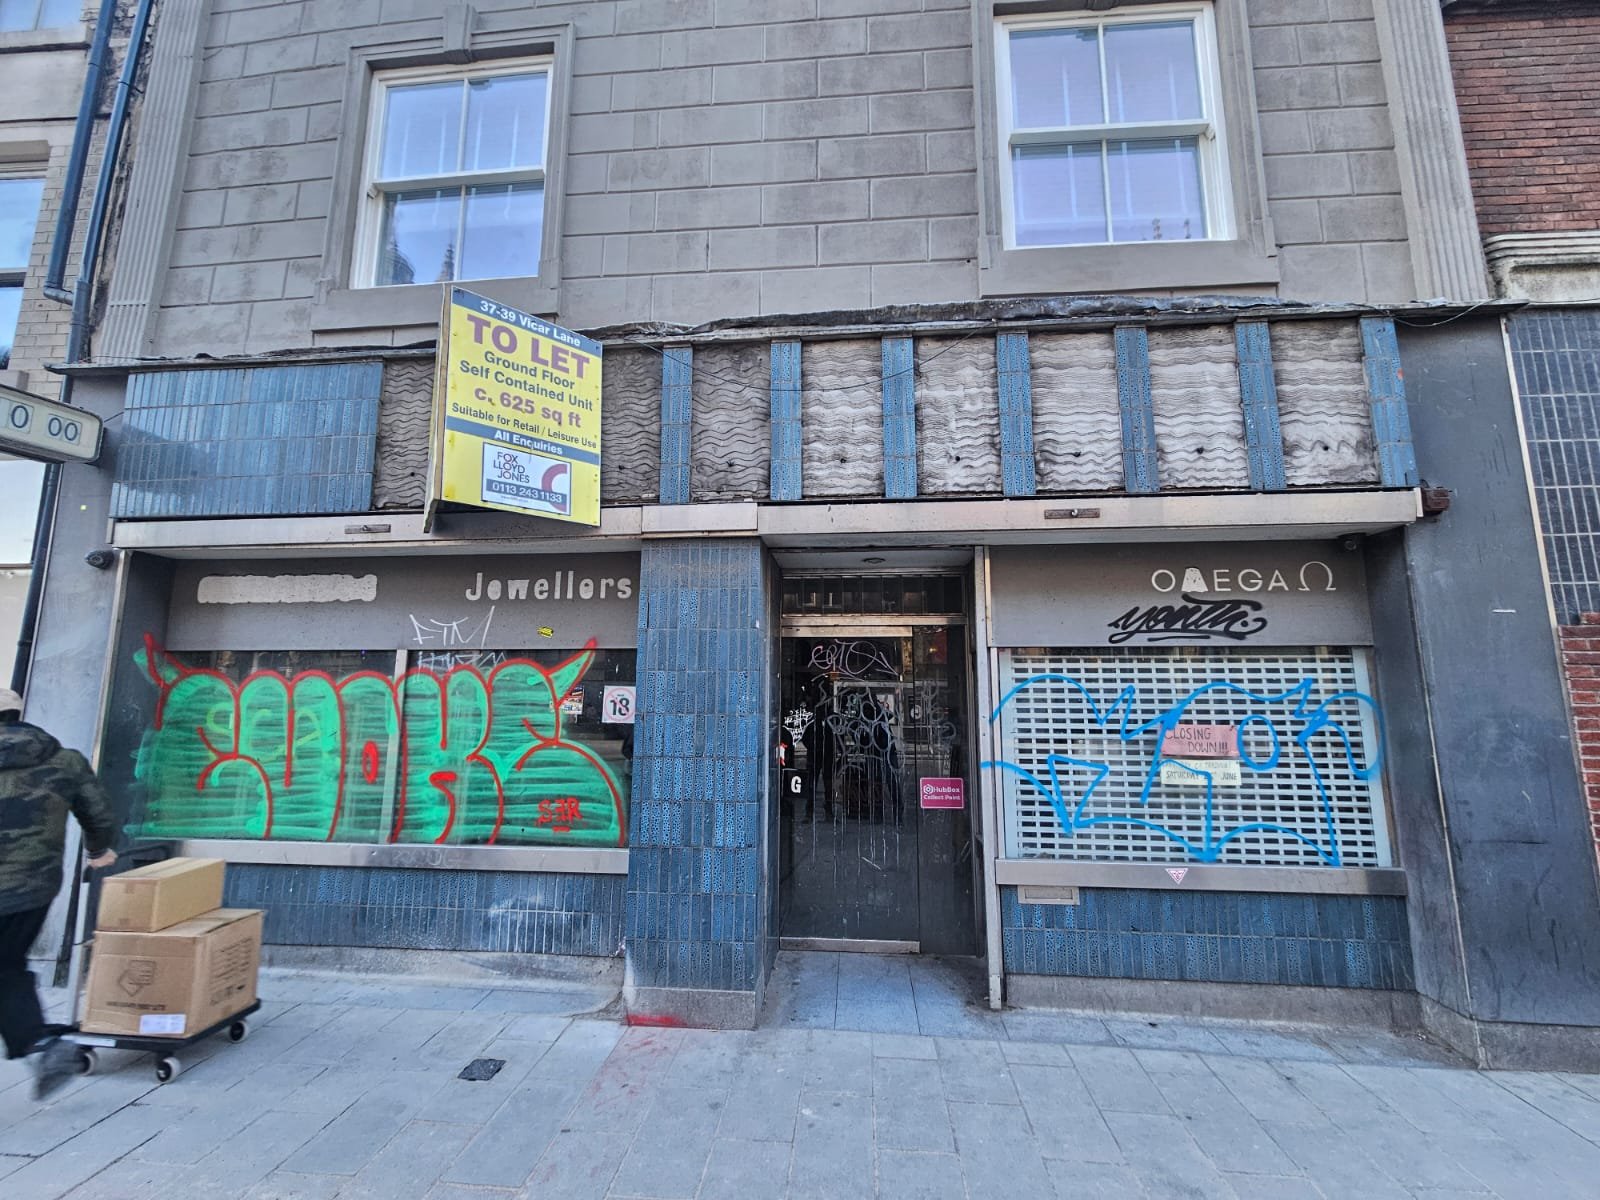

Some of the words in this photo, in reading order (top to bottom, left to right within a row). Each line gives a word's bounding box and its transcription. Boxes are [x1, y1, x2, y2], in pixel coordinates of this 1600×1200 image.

[480, 300, 516, 322] 37-39
[519, 313, 551, 335] Vicar
[553, 329, 581, 346] Lane
[466, 313, 518, 354] TO
[531, 337, 591, 379] LET
[484, 350, 537, 378] Ground
[542, 369, 575, 389] Floor
[459, 360, 490, 379] Self
[494, 371, 564, 402] Contained
[569, 393, 593, 411] Unit
[499, 392, 535, 415] 625
[541, 406, 562, 426] sq
[568, 411, 582, 428] ft
[452, 402, 495, 422] Suitable
[496, 414, 511, 426] for
[513, 419, 540, 434] Retail
[547, 428, 580, 444] Leisure
[581, 437, 597, 449] Use
[494, 430, 510, 441] All
[513, 435, 563, 455] Enquiries
[493, 459, 526, 474] LLOYD
[497, 451, 519, 465] FOX
[497, 470, 530, 484] JONES
[492, 482, 517, 494] 0113
[519, 487, 538, 499] 243
[540, 491, 563, 503] 1133
[609, 697, 630, 717] 18
